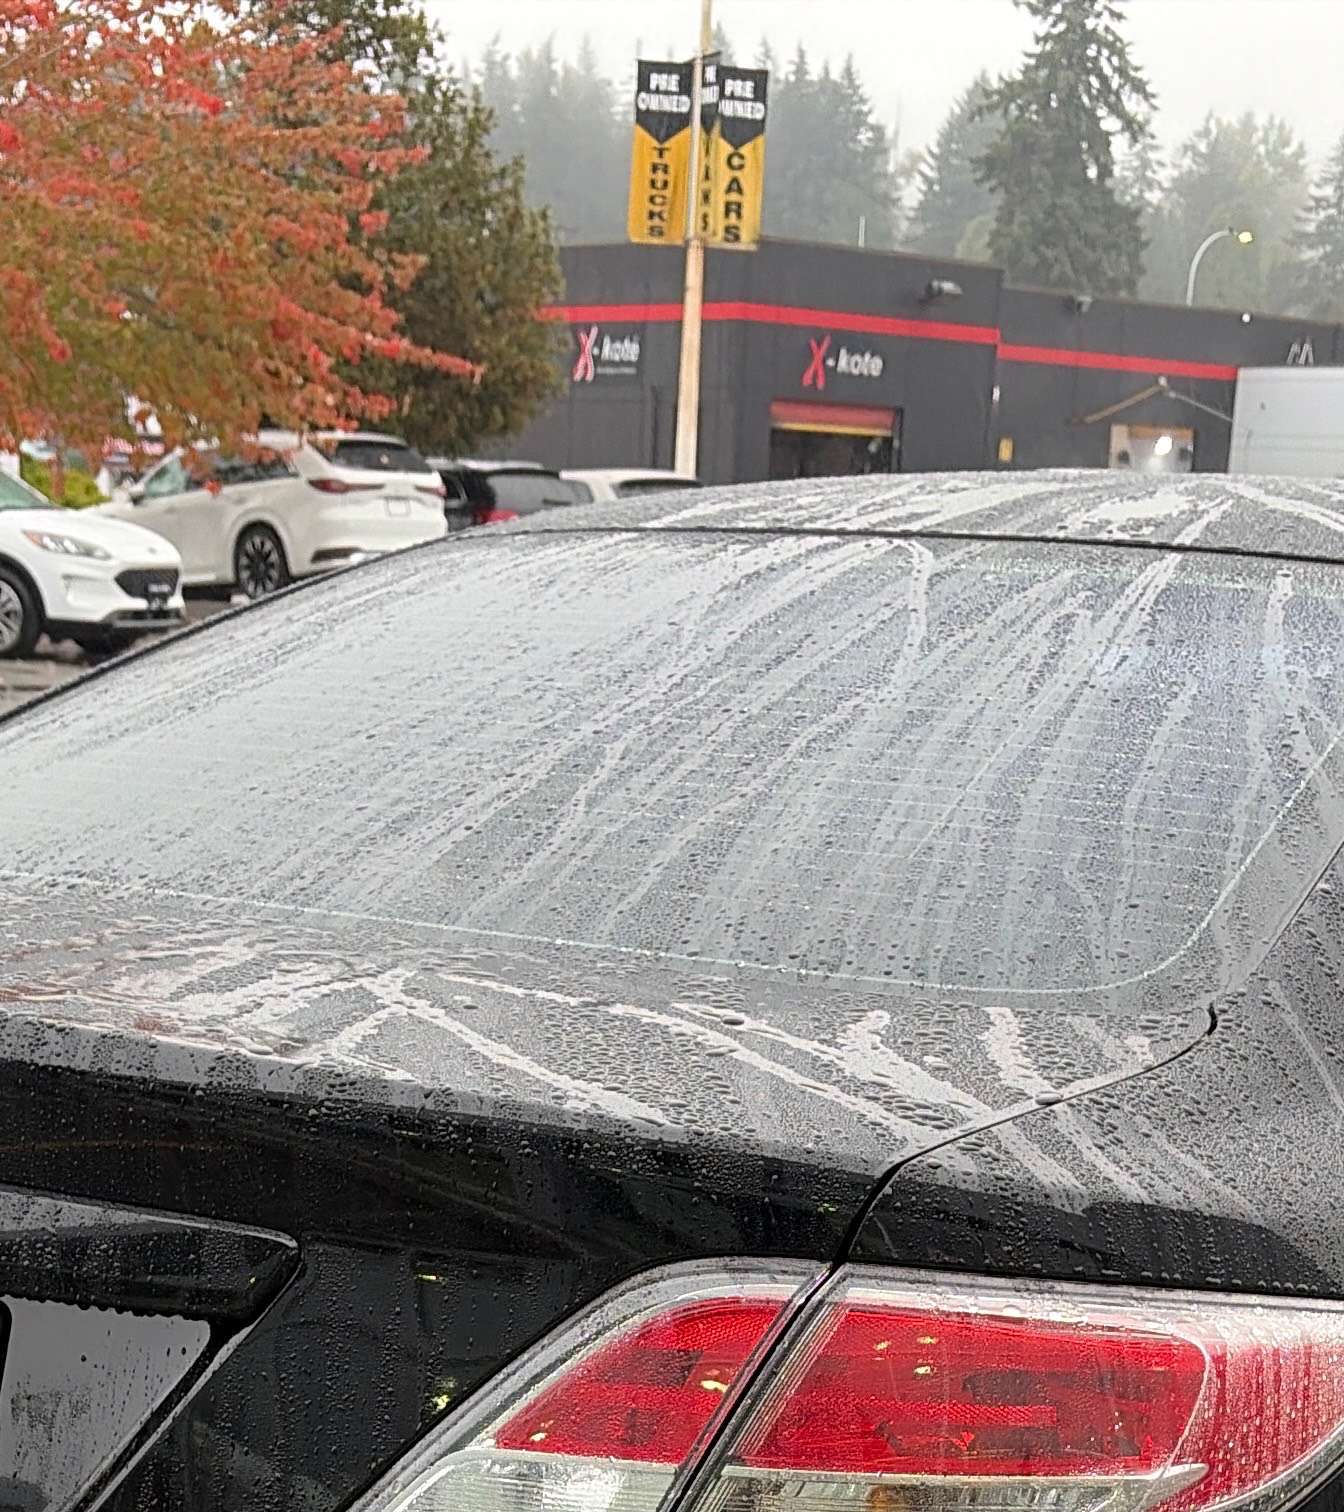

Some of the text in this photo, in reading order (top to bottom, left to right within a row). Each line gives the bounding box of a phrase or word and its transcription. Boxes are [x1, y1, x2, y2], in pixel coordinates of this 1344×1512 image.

[649, 72, 680, 92] PRE
[724, 79, 754, 98] PRE
[637, 92, 691, 113] OWNED
[718, 99, 765, 121] WNED
[648, 147, 670, 238] TRUCKS
[724, 151, 745, 243] CARS
